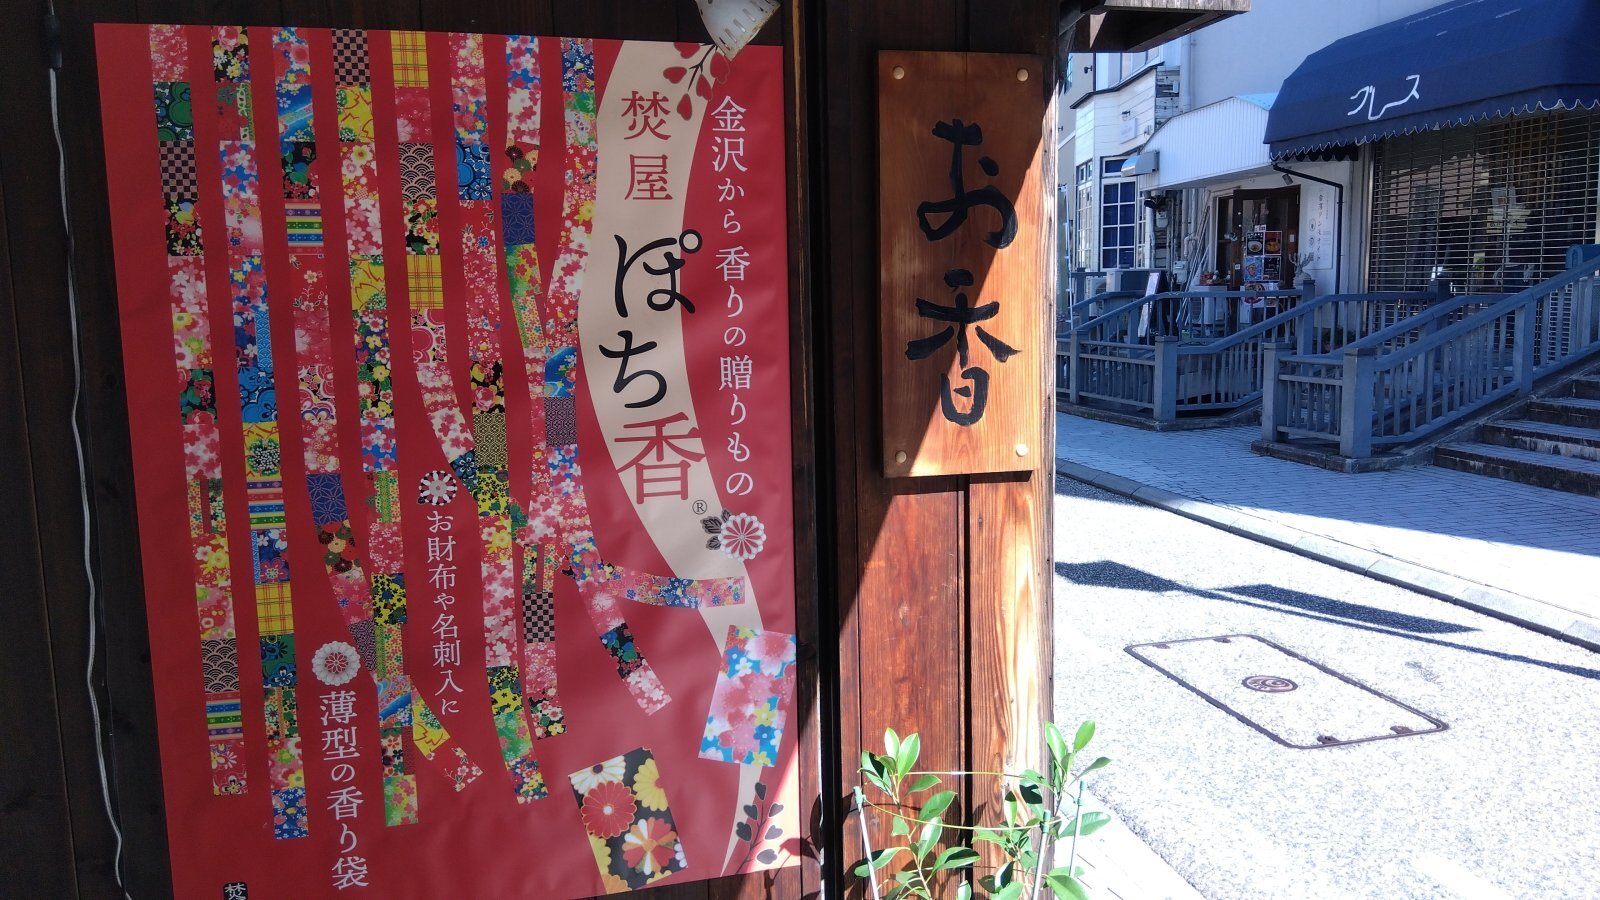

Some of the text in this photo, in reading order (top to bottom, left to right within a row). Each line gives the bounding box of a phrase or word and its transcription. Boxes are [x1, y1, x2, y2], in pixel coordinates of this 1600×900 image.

[621, 90, 673, 201] 焚屋
[598, 228, 706, 505] ぽち香
[711, 95, 754, 496] 金沢から香りの贈りもの
[904, 118, 1022, 427] お香
[426, 510, 464, 715] お財布や名刺入に
[319, 690, 370, 890] 薄型の香り袋
